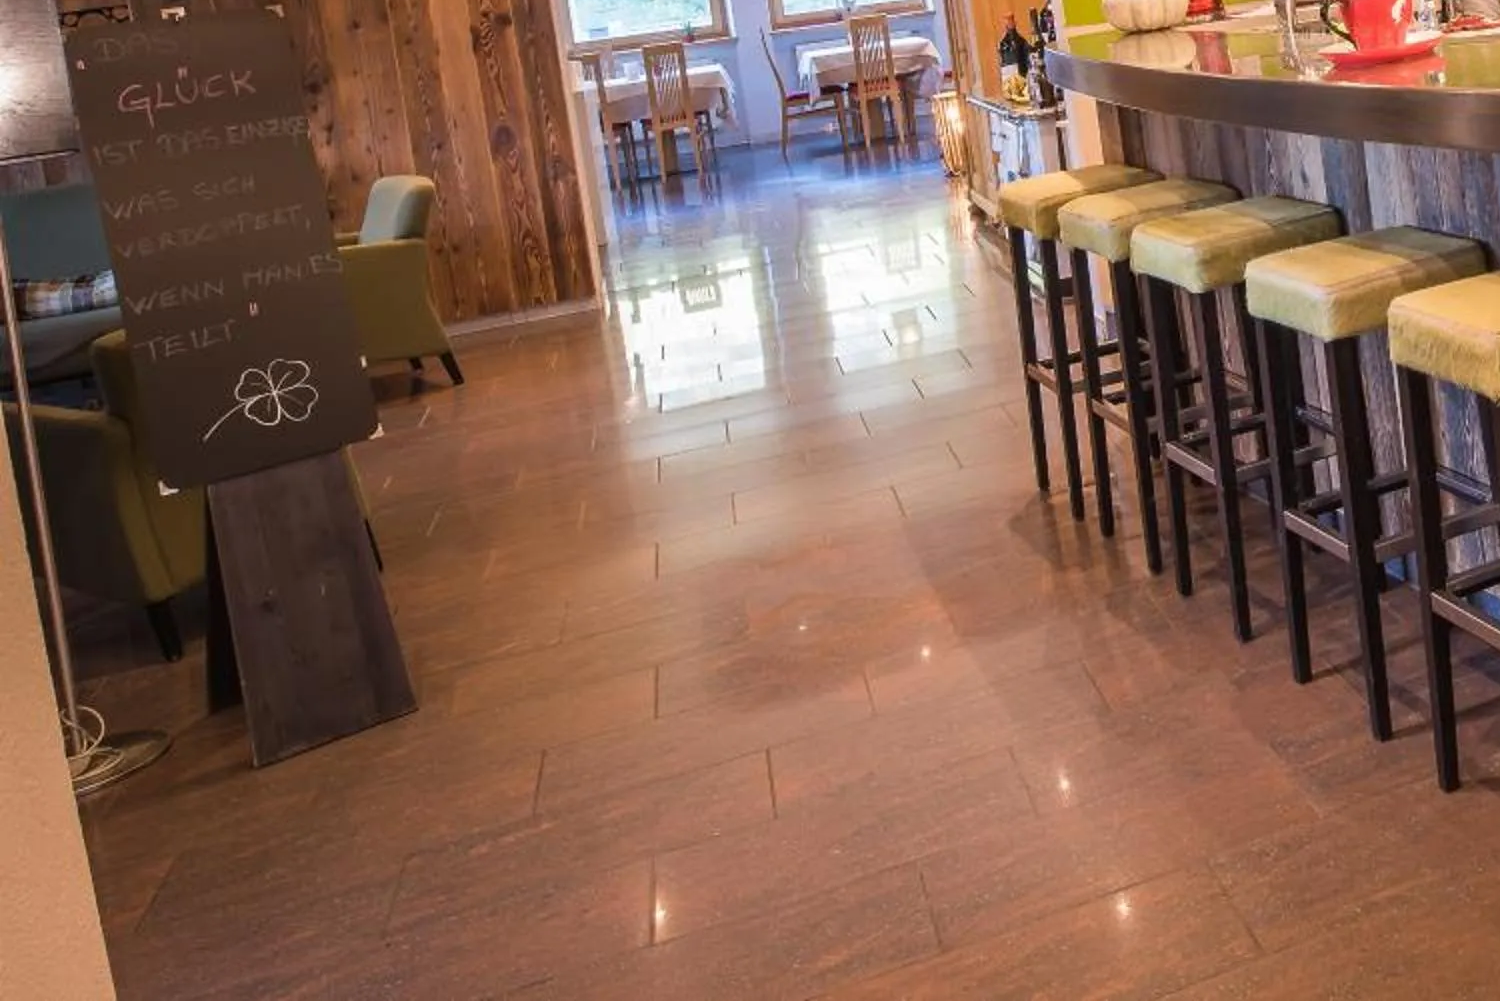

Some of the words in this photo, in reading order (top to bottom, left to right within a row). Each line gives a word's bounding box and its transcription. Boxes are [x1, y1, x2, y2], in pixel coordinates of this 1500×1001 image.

[94, 29, 179, 63] DAS
[117, 66, 257, 128] GLÜCK
[92, 138, 144, 167] IST
[156, 126, 222, 158] DAS
[103, 186, 180, 221] WAS
[192, 173, 256, 202] SICH
[124, 278, 225, 317] WENN
[308, 253, 344, 277] ES
